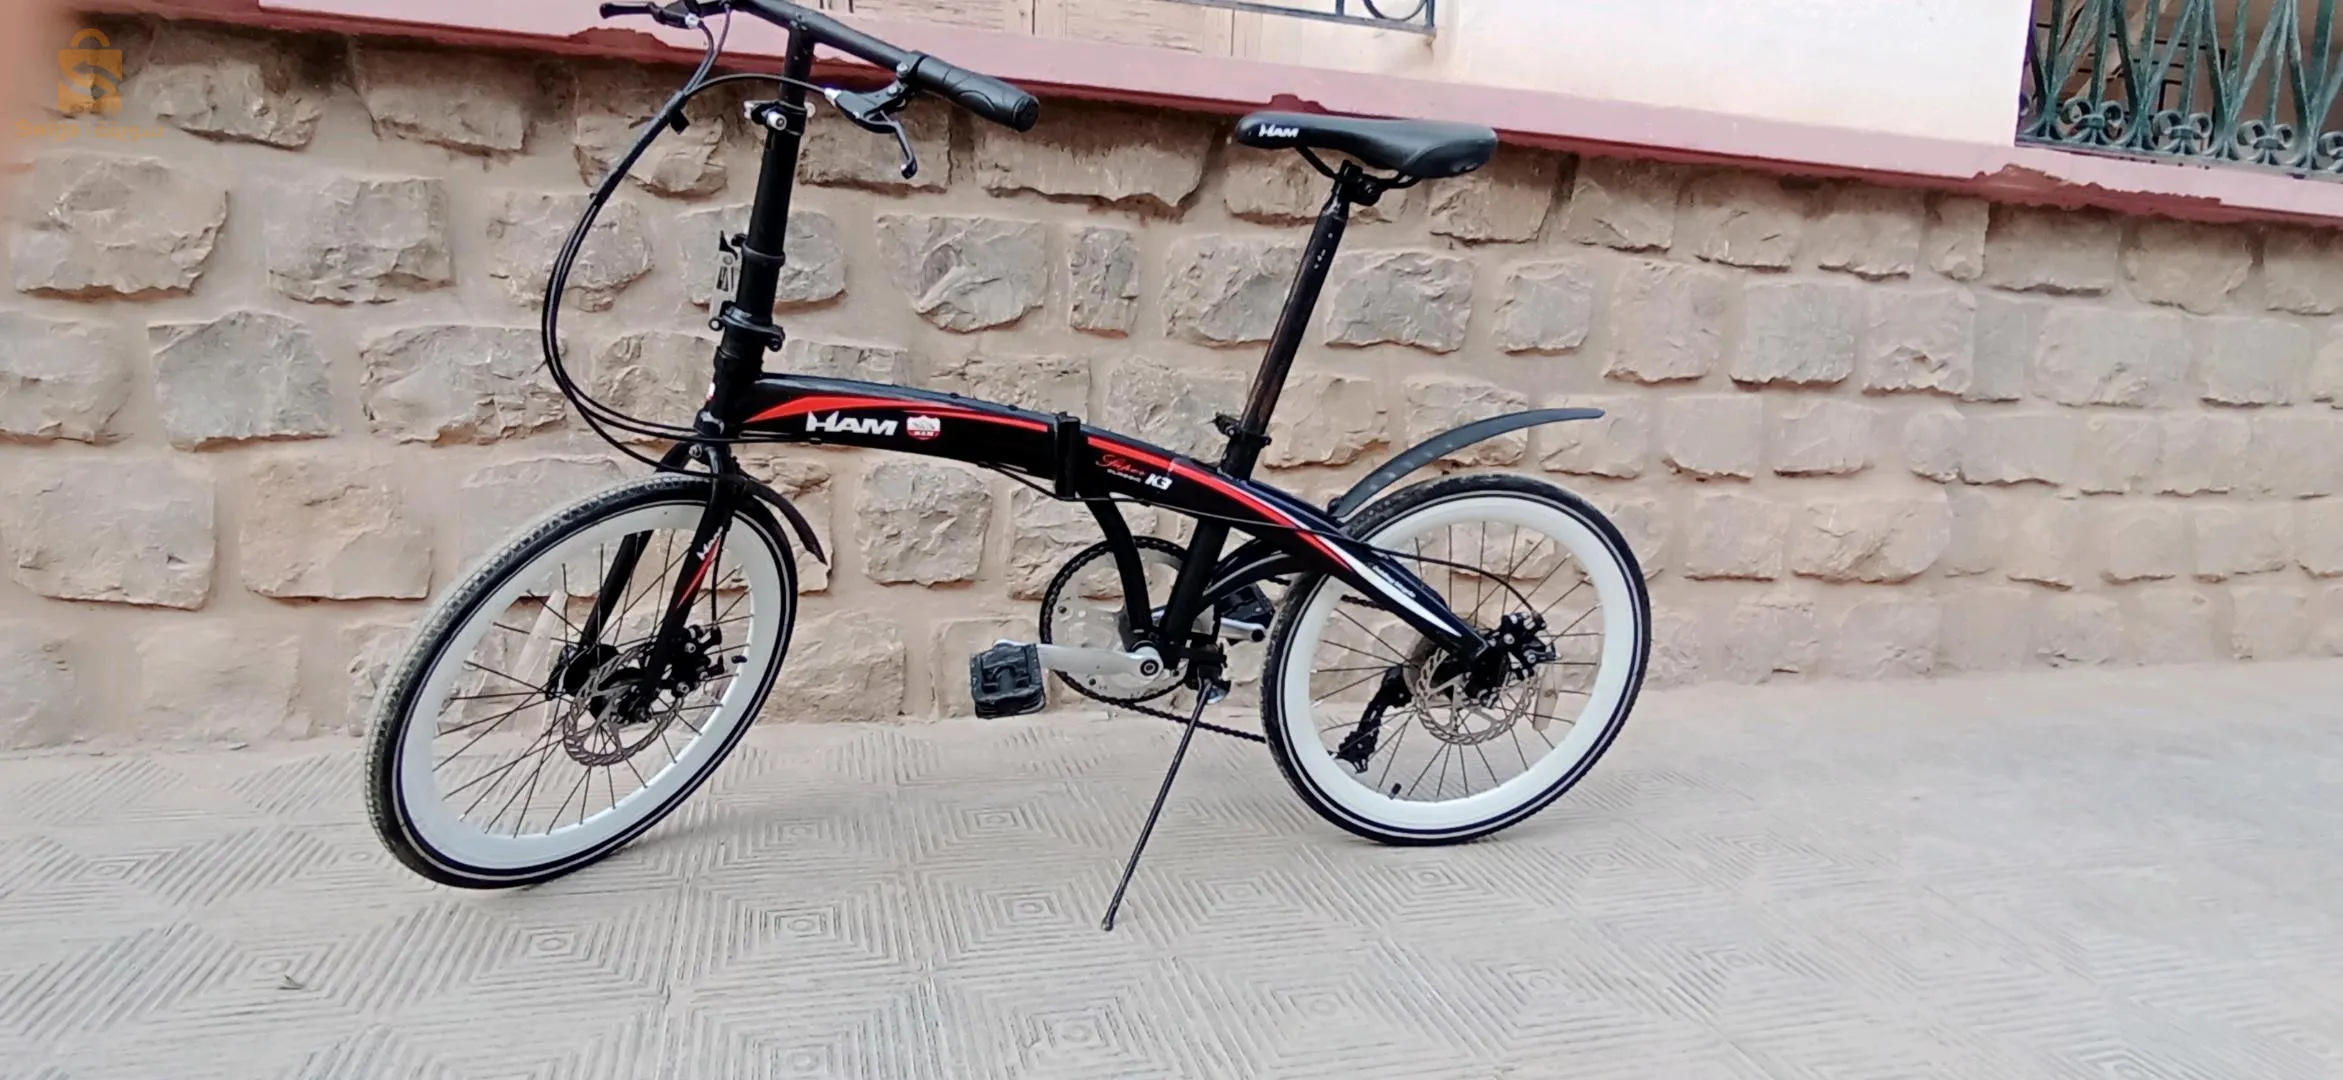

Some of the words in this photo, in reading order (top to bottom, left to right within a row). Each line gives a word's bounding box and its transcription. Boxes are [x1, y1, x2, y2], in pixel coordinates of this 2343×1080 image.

[1258, 123, 1300, 138] HAM
[806, 410, 898, 436] HAM
[1144, 472, 1173, 490] K3
